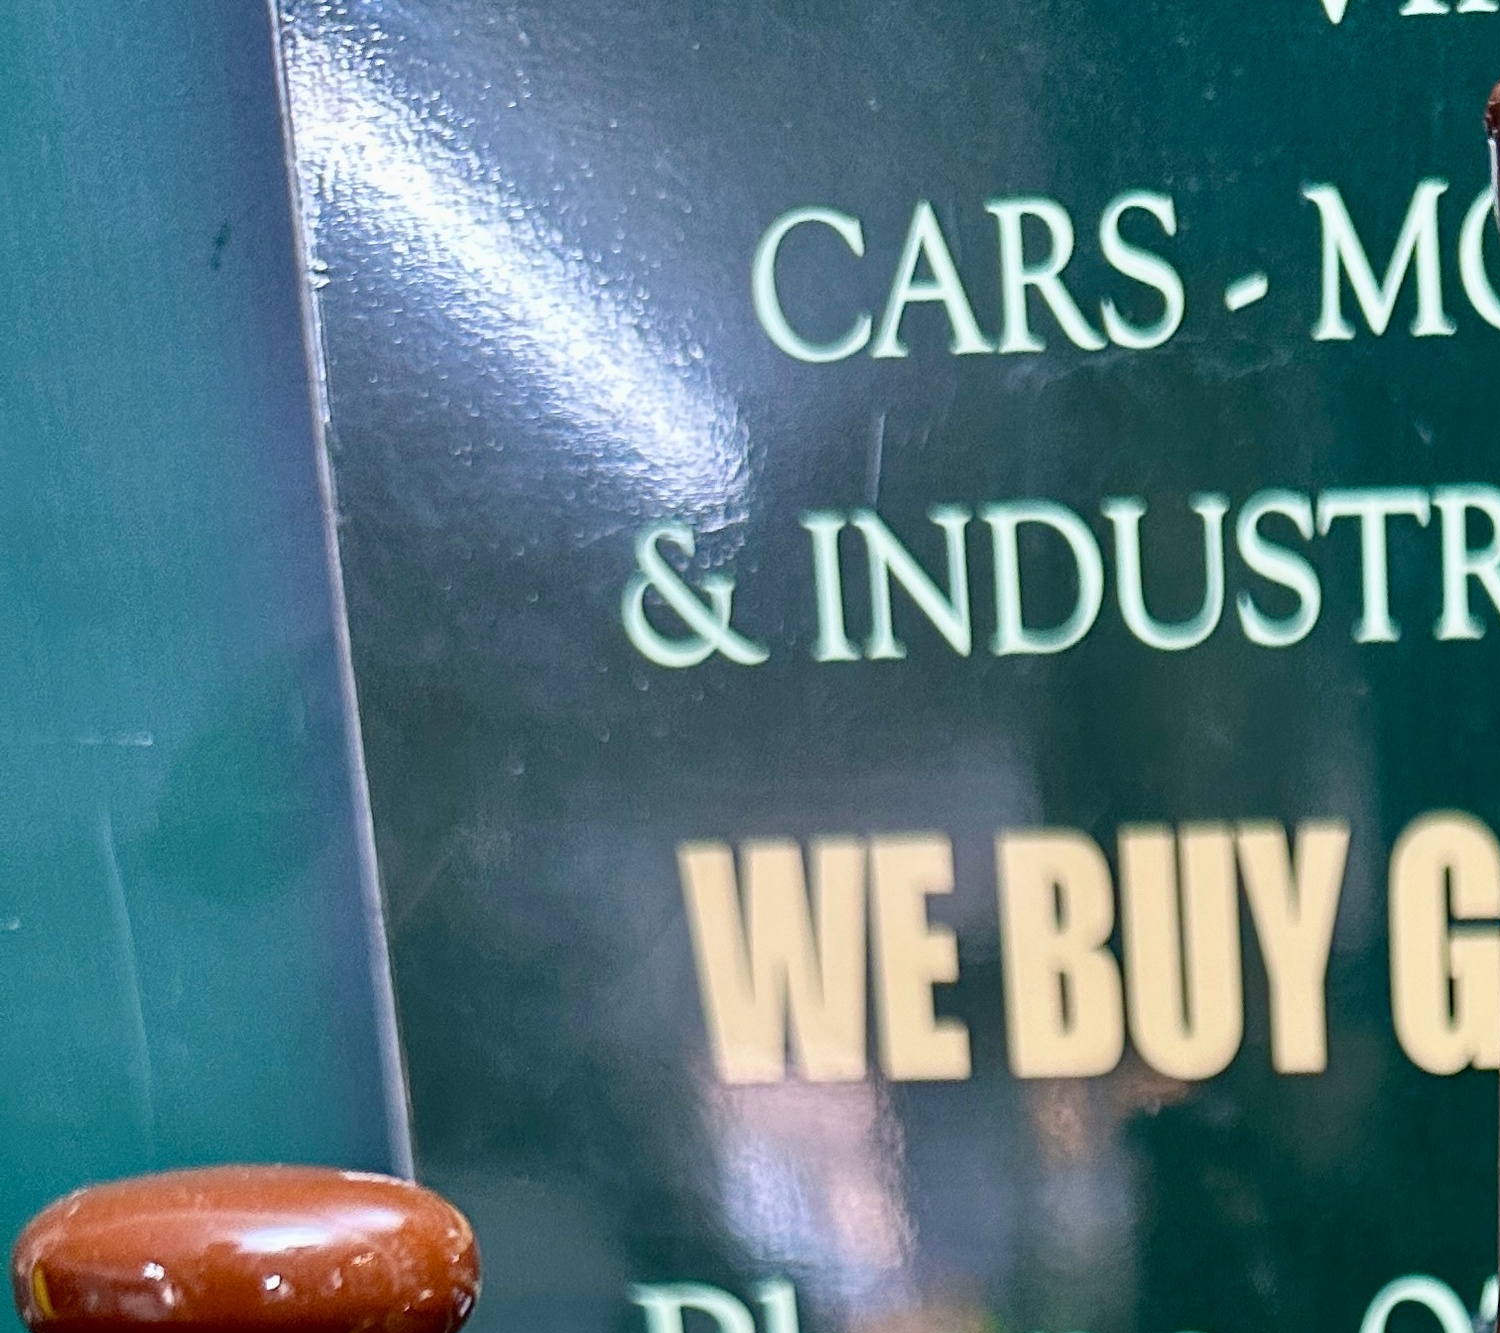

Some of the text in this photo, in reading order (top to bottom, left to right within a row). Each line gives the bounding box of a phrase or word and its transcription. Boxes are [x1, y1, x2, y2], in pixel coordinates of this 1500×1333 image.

[751, 191, 1186, 364] CARS
[619, 519, 770, 668] &
[676, 829, 972, 1085] WE
[998, 818, 1352, 1081] BUY
